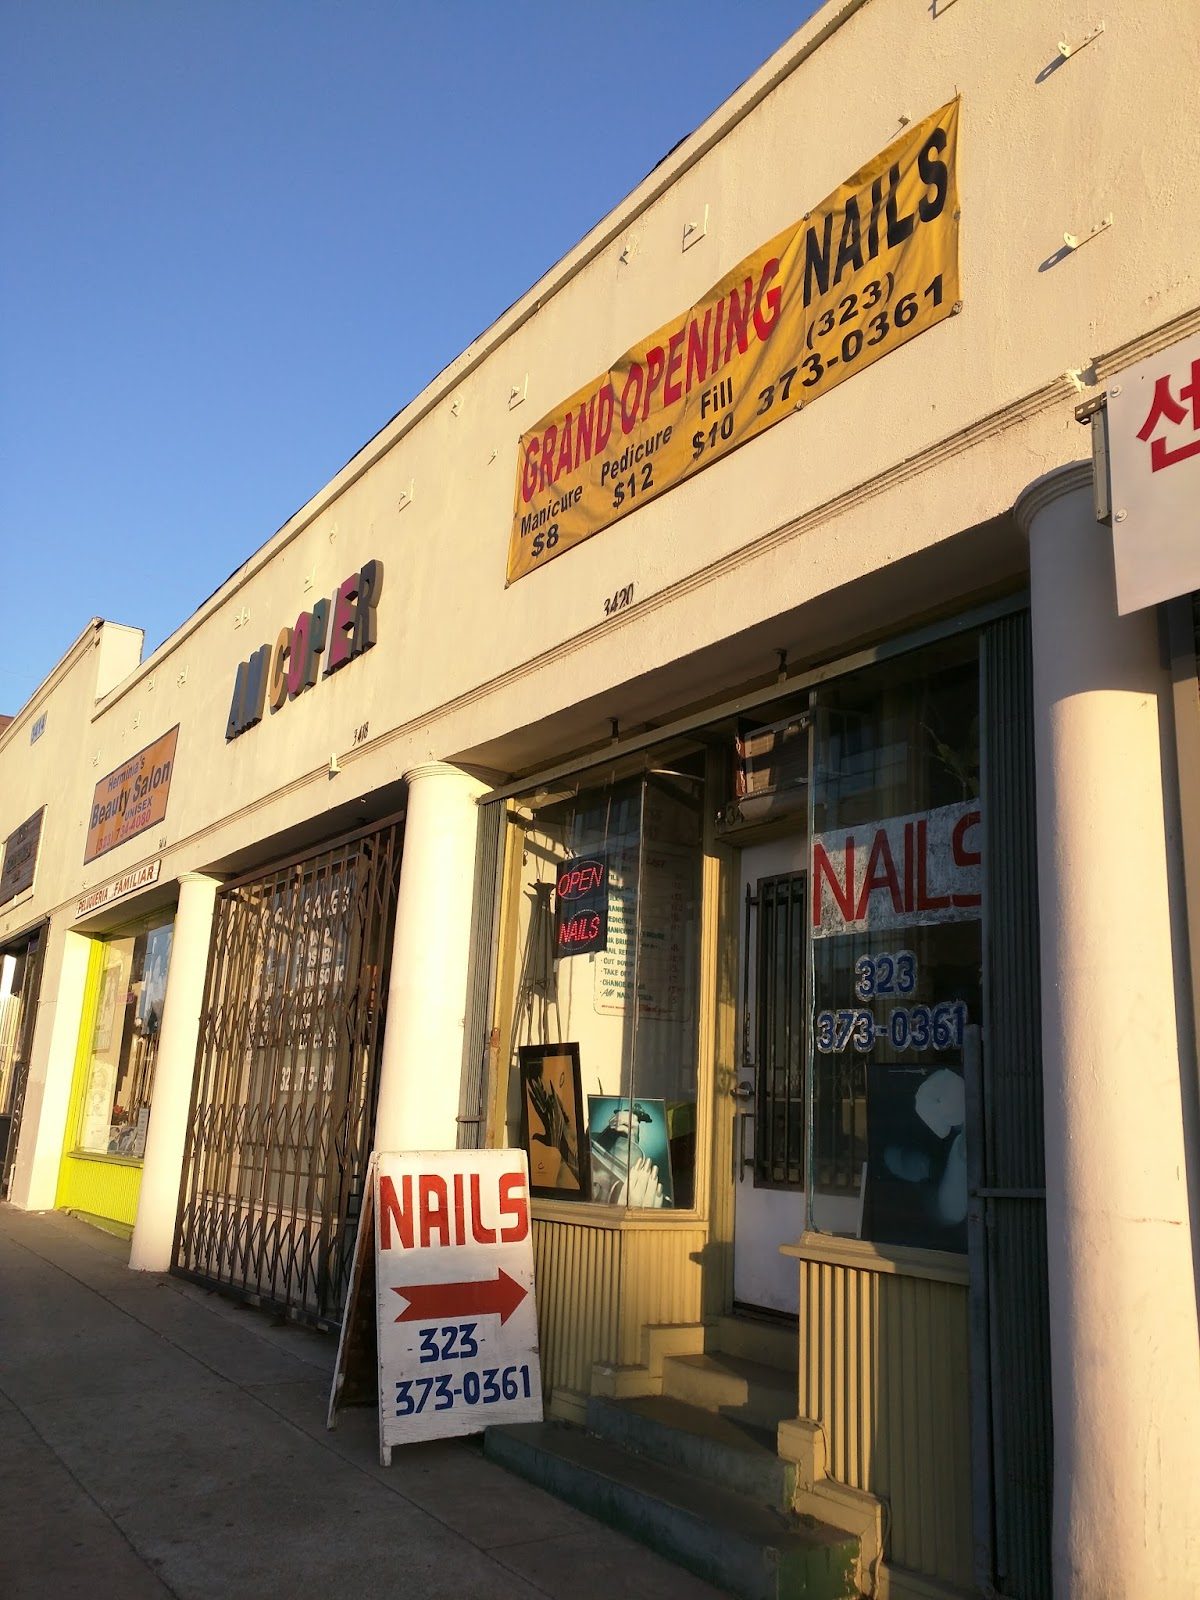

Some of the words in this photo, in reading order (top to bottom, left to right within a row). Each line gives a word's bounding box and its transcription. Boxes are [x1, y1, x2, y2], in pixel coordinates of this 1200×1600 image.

[523, 384, 615, 503] GRAND
[620, 257, 783, 435] OPENING
[802, 127, 947, 308] NAILS
[806, 272, 895, 350] (323)
[756, 274, 945, 416] 373-0361
[520, 484, 583, 538] Manicure
[600, 424, 673, 487] Pedicure
[700, 376, 733, 419] Fill
[531, 525, 560, 558] $8
[613, 463, 654, 508] $12
[692, 411, 734, 460] $10
[604, 583, 634, 616] 3420
[91, 787, 130, 830] Beauty
[133, 760, 171, 800] Salon
[108, 755, 146, 792] Herminia's
[124, 795, 153, 822] UNISEX
[113, 865, 154, 897] FAMILIAR
[558, 864, 604, 897] OPEN
[559, 916, 600, 944] NAILS
[858, 955, 915, 995] 323
[819, 1006, 963, 1049] 373-0361
[380, 1172, 530, 1250] NAILS
[395, 1365, 531, 1417] 373-0361
